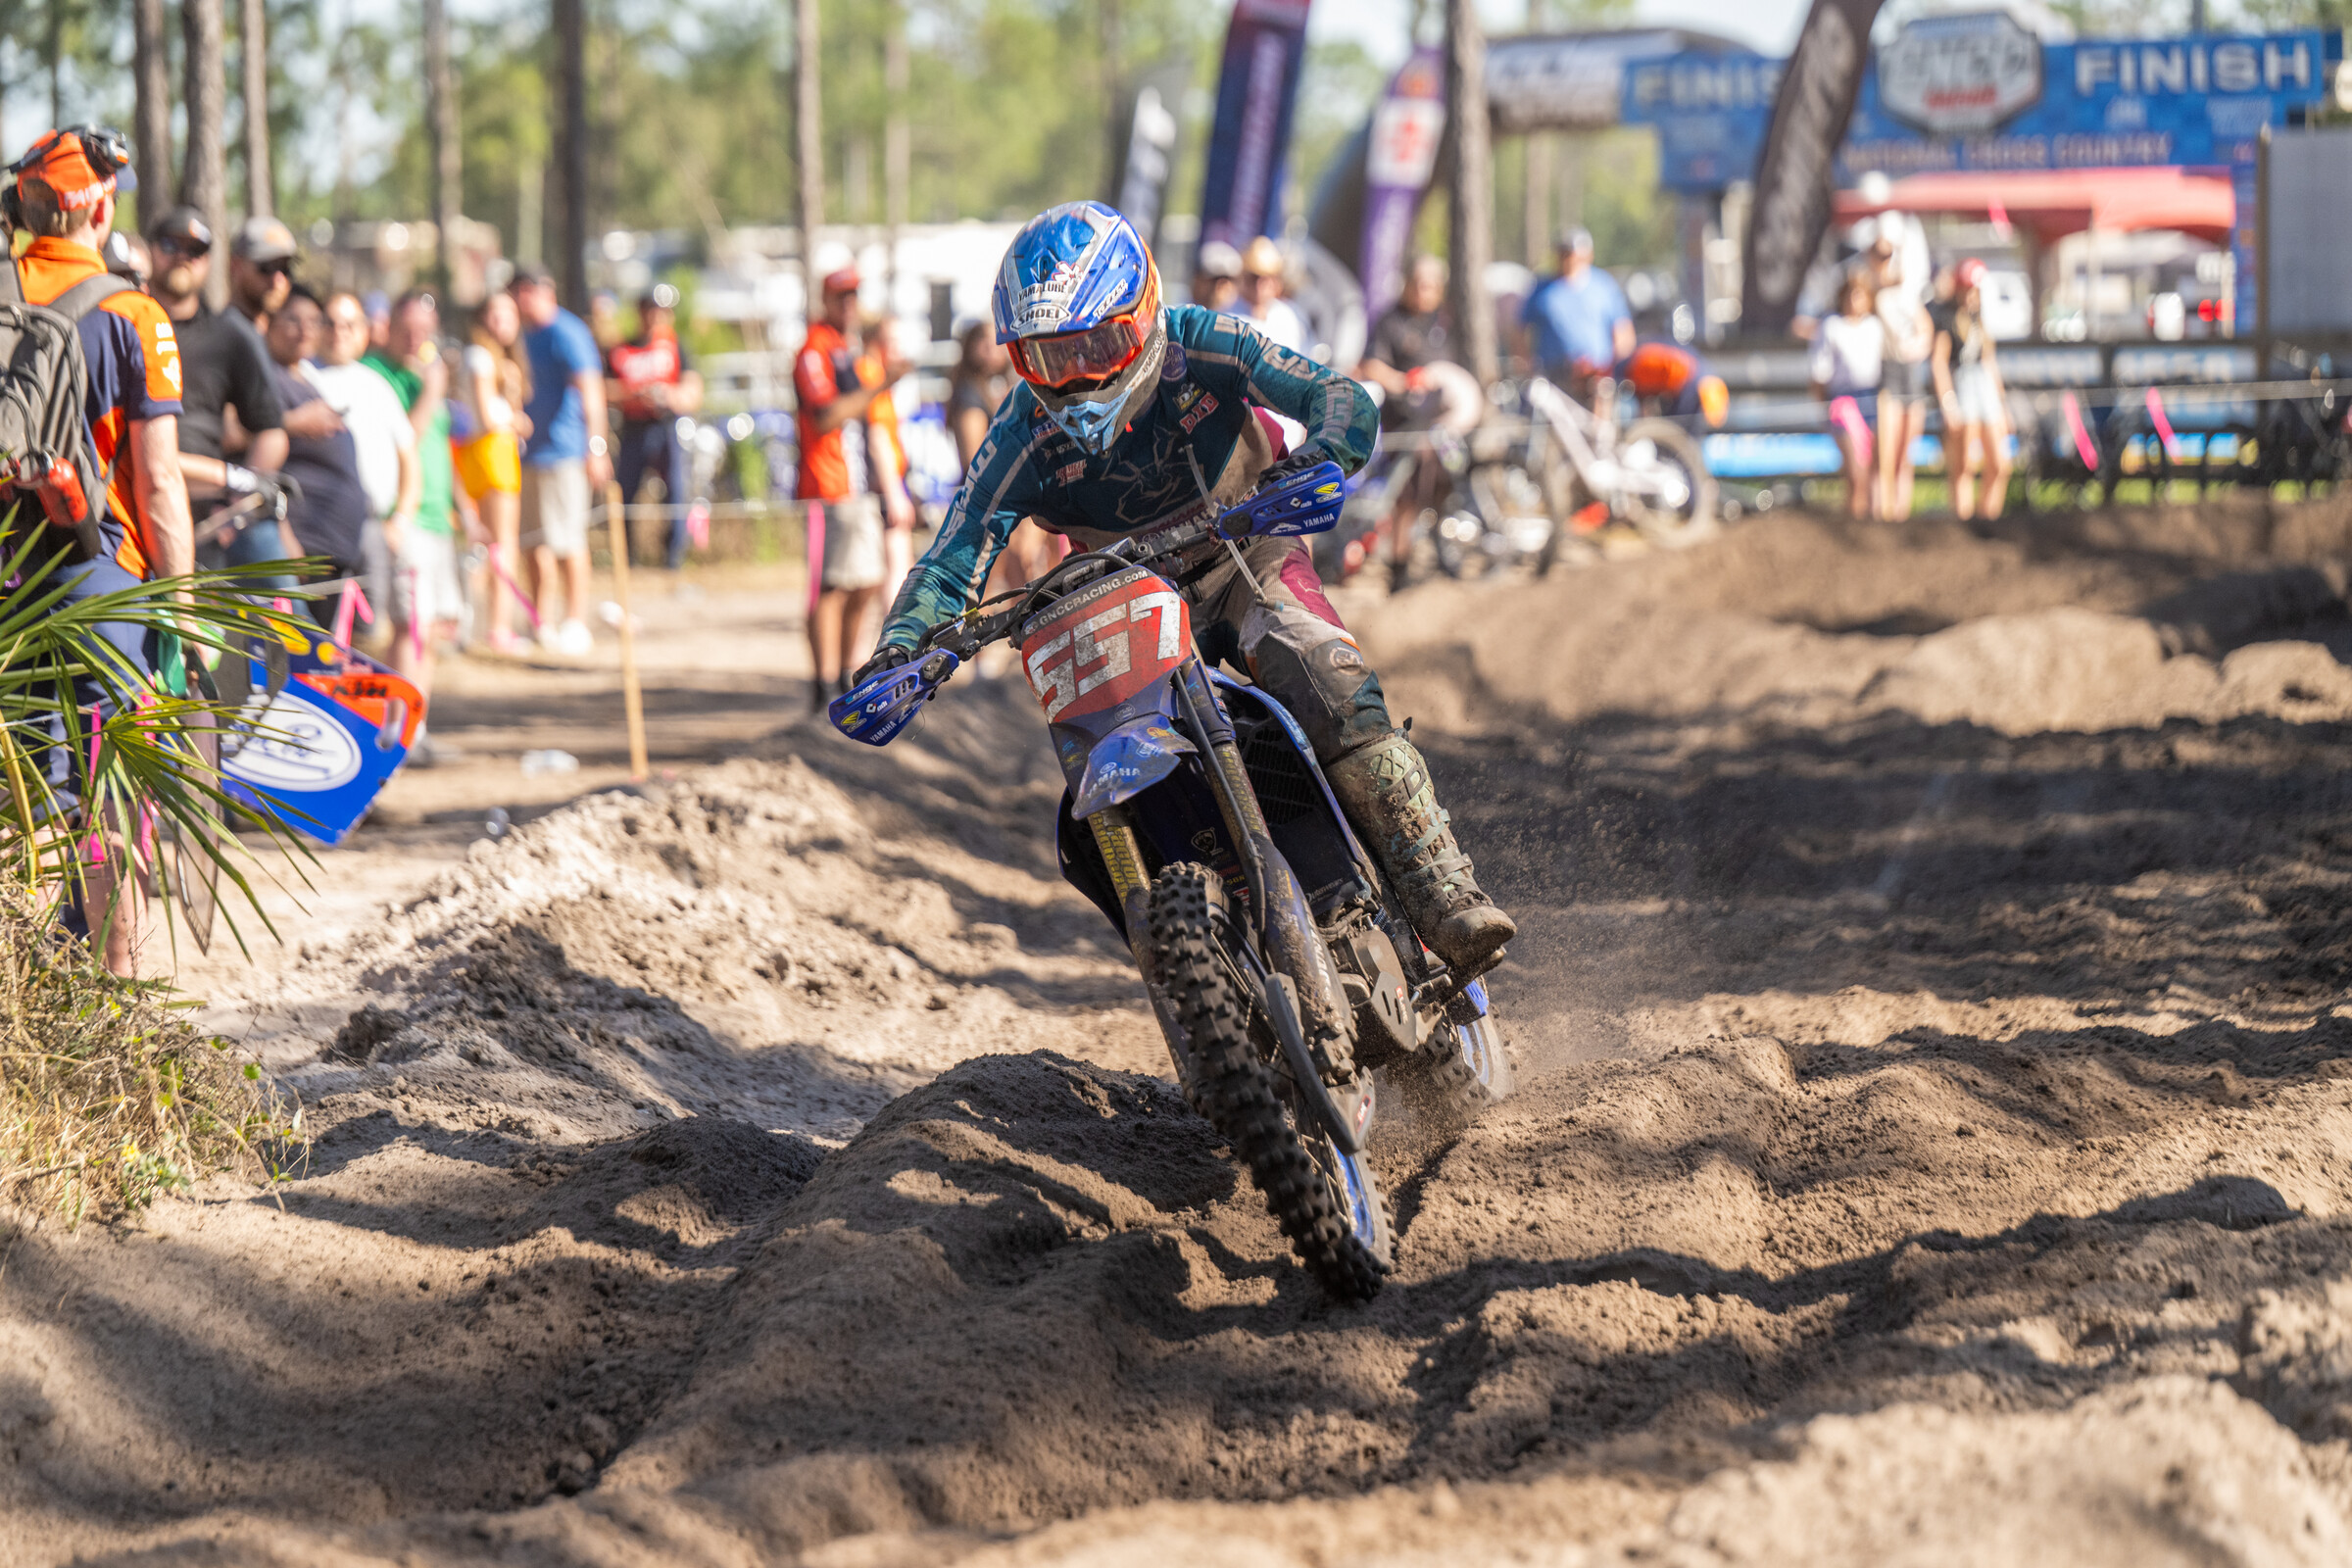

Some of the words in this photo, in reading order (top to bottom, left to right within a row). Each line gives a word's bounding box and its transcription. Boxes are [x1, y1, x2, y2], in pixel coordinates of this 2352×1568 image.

[1635, 64, 1780, 109] FINI
[2075, 41, 2311, 96] FINISH
[1018, 309, 1059, 324] SHOEI
[1302, 513, 1335, 528] YAMAHA
[1039, 569, 1148, 626] GNCCRACING.COM
[1027, 591, 1181, 723] 557
[869, 720, 898, 743] YAMAHA
[1087, 766, 1141, 798] YAMAHA
[1105, 825, 1141, 885] Factor
